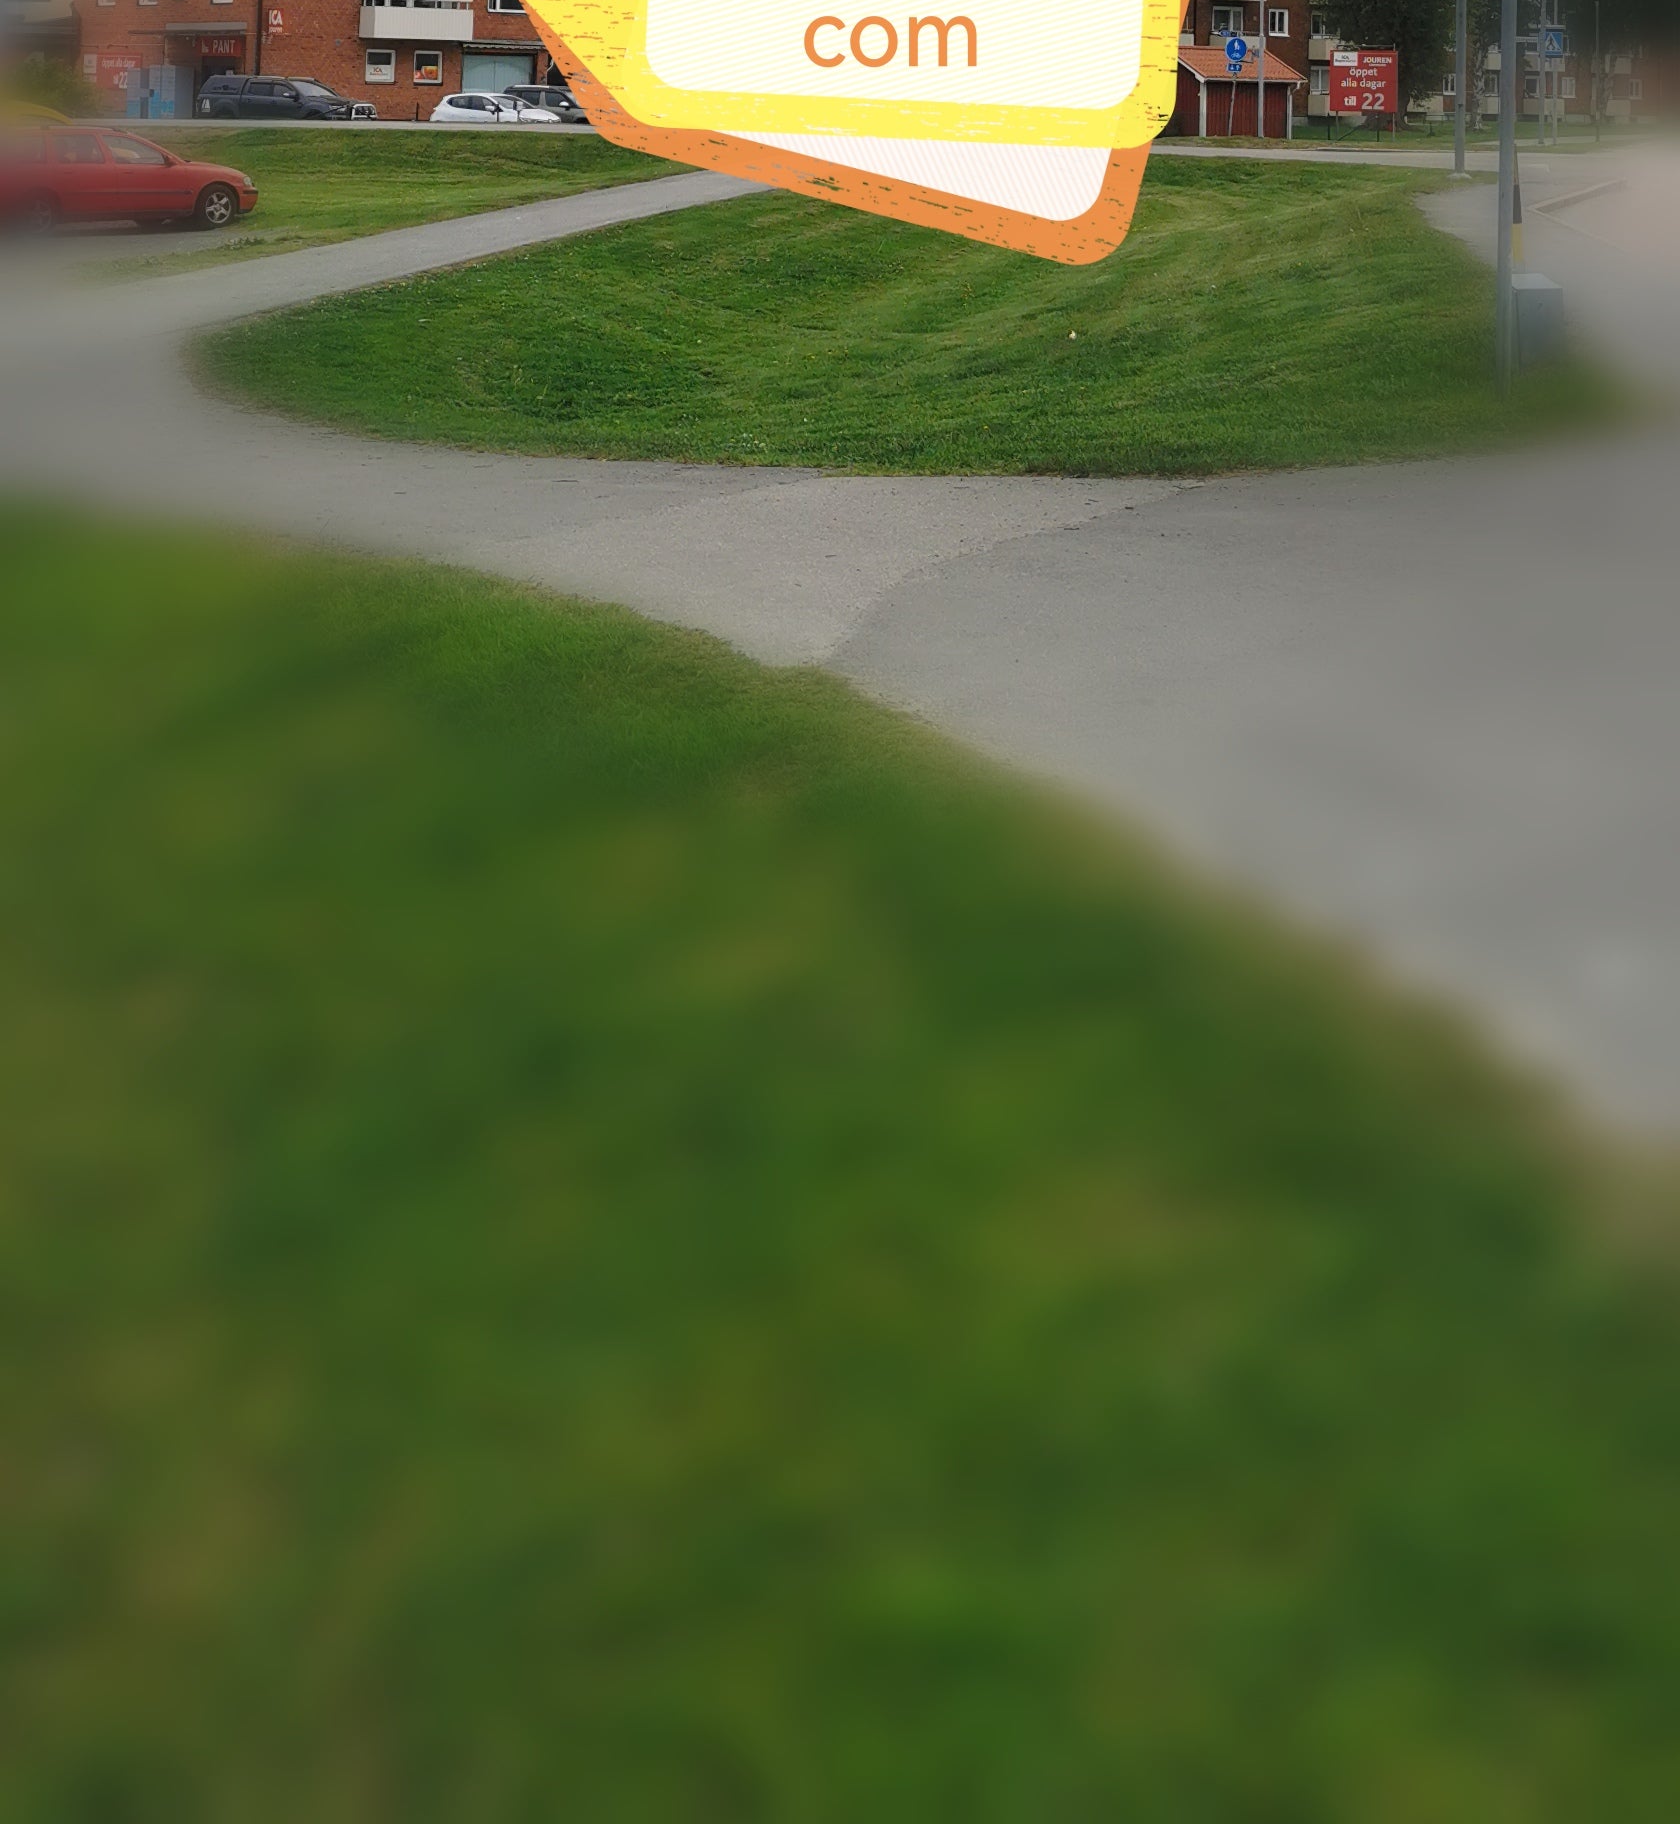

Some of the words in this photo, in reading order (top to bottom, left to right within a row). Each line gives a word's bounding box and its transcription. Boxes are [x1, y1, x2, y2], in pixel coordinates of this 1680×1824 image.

[268, 9, 283, 25] ICA
[212, 39, 236, 54] PANT
[1349, 67, 1378, 78] öppet
[1341, 78, 1357, 87] alla
[1360, 78, 1386, 90] dagar
[1344, 95, 1357, 106] till
[1361, 92, 1385, 110] 22
